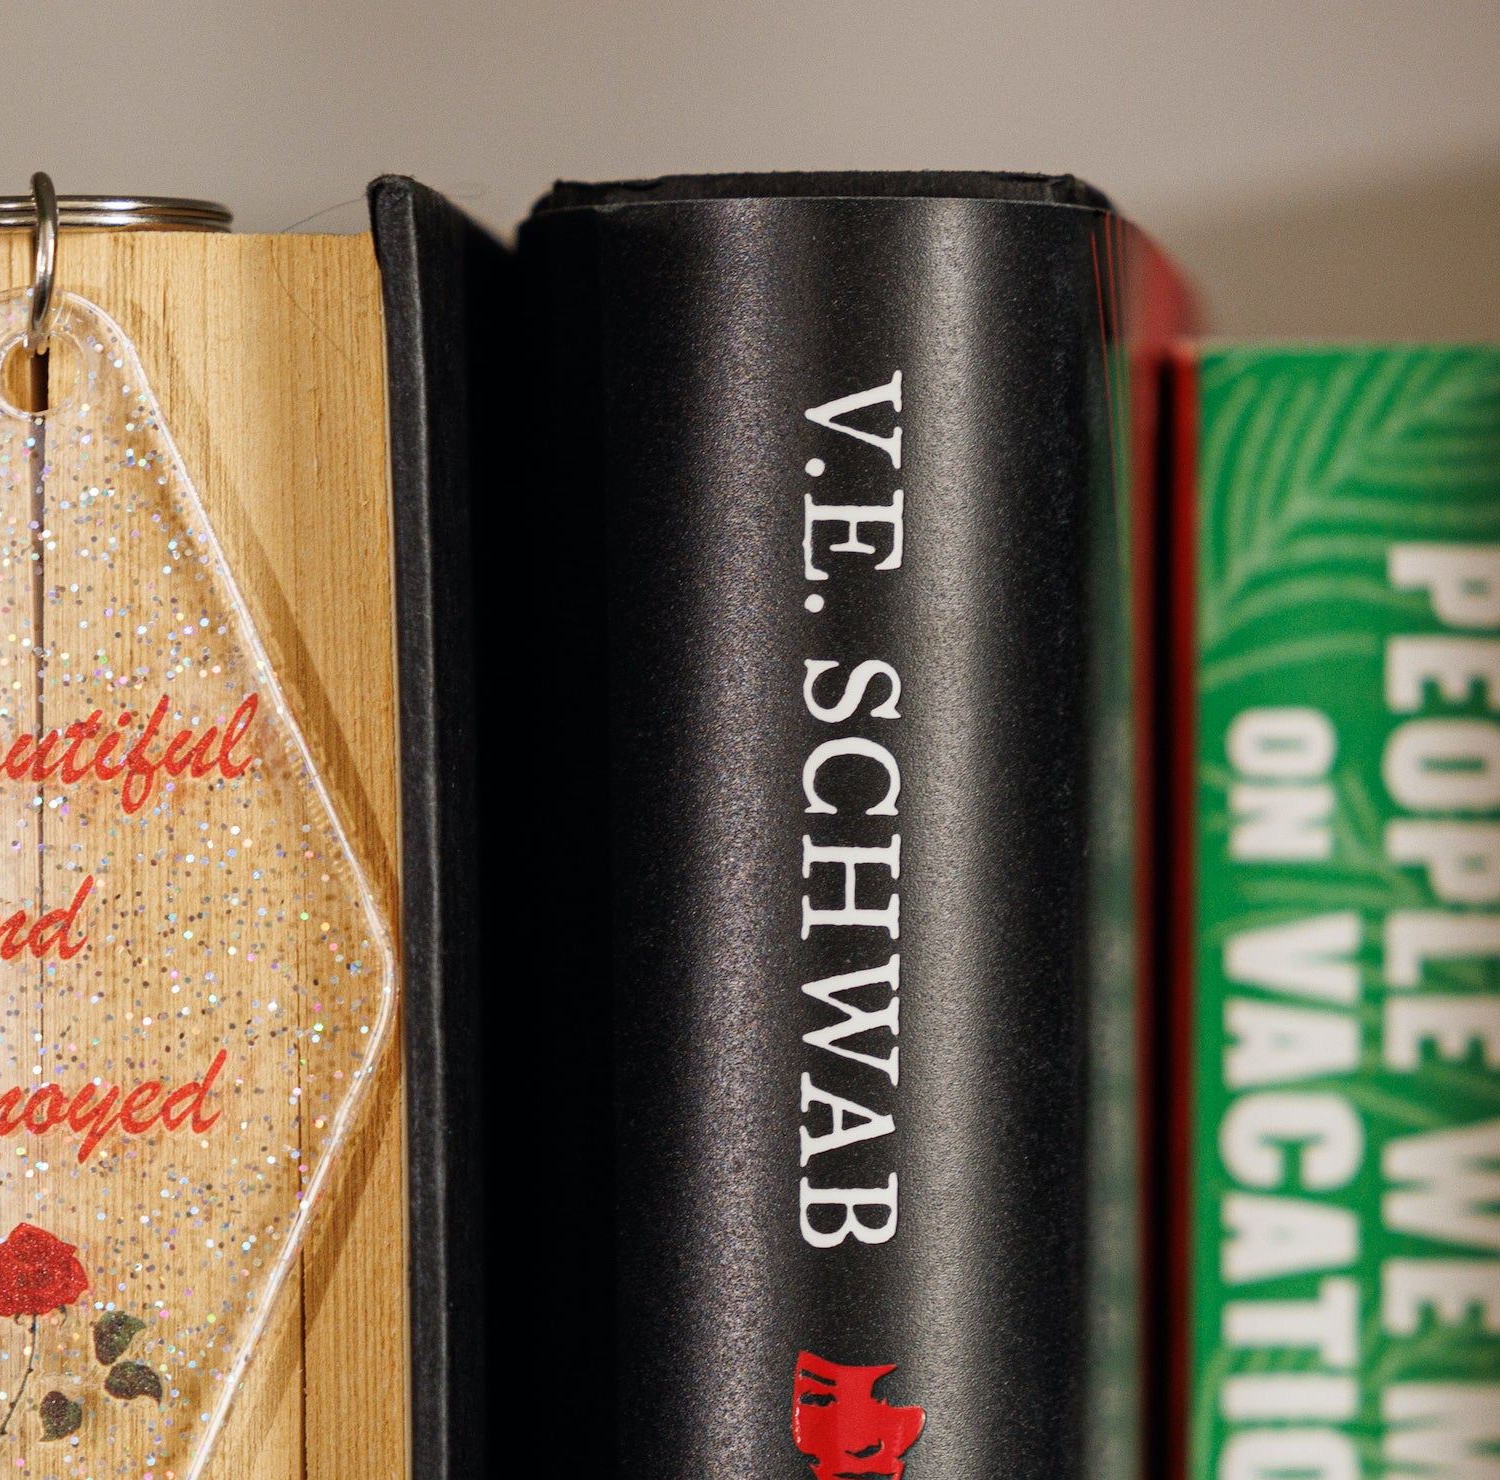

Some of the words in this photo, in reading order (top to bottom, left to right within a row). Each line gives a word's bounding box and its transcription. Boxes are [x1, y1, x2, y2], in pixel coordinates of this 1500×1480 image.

[800, 369, 905, 614] V.E.
[1225, 705, 1339, 864] ON
[1382, 541, 1500, 1074] PEOPLE
[798, 658, 904, 1249] SCHWAB
[1380, 1115, 1500, 1337] WE
